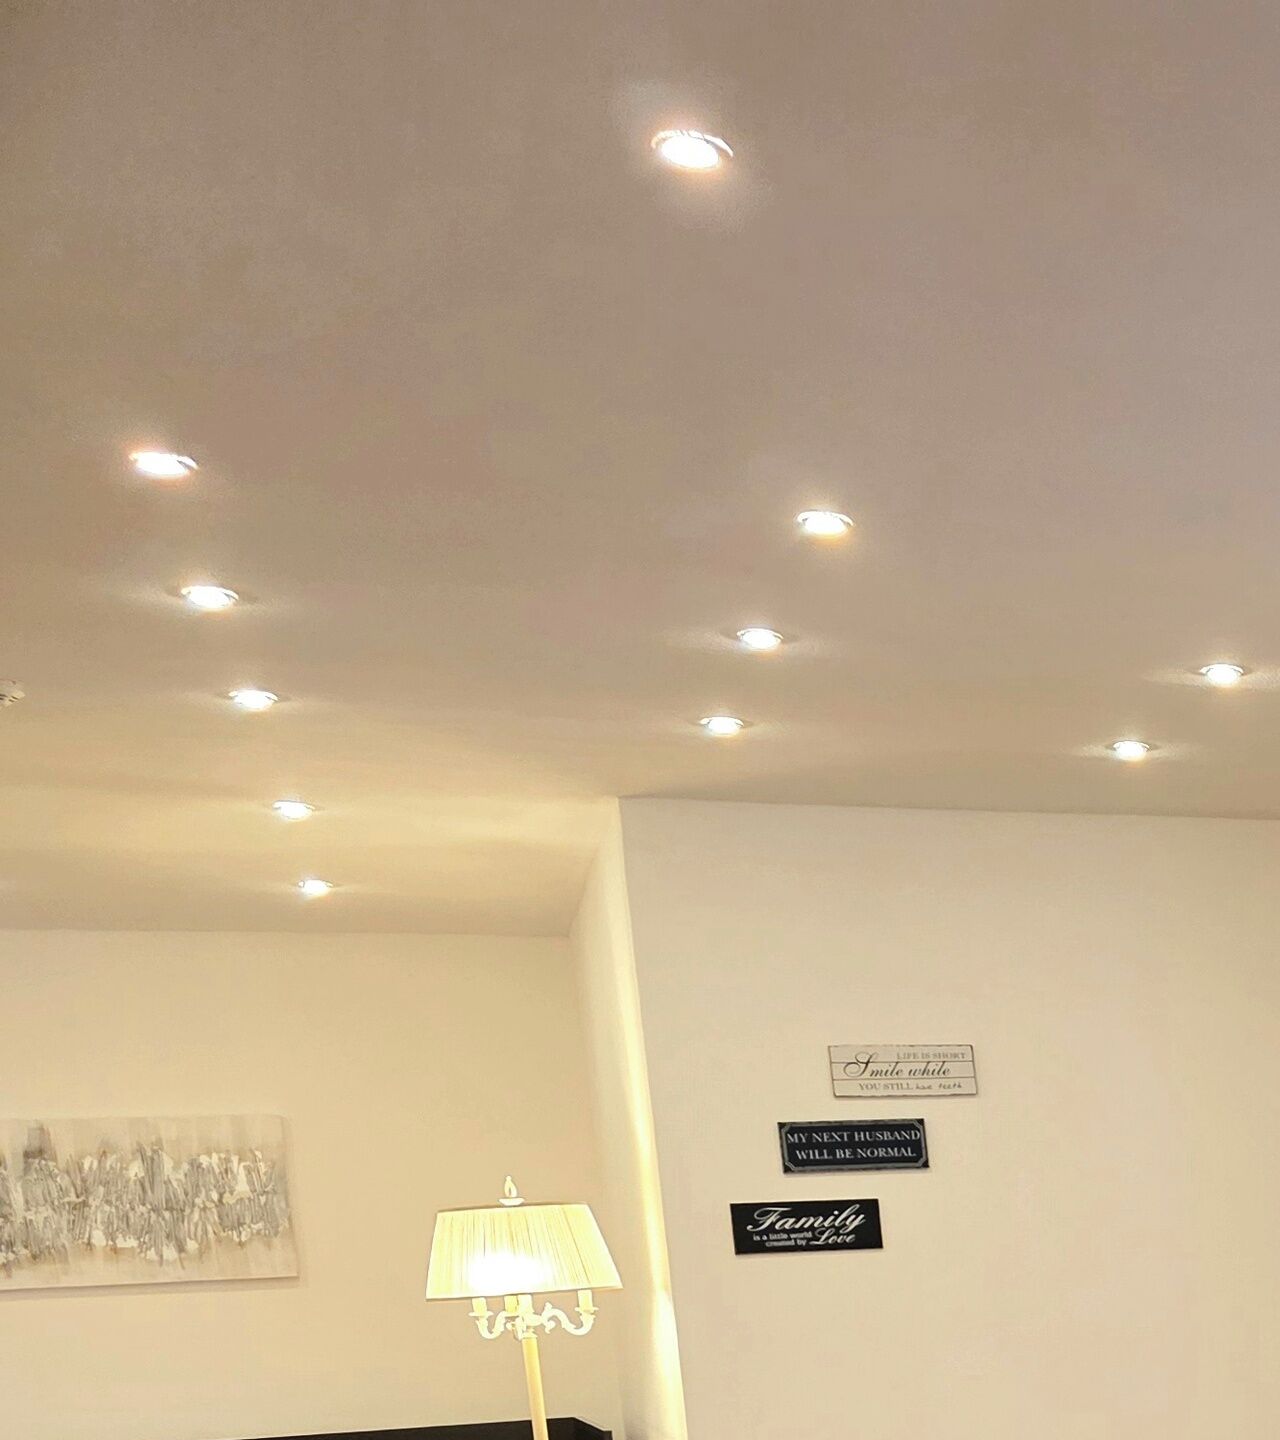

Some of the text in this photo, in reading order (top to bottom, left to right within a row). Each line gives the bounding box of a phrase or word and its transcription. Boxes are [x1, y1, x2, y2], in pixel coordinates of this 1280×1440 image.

[896, 1051, 966, 1060] LIFE IS SHORT
[843, 1051, 951, 1077] Smile while
[858, 1083, 881, 1091] YOU
[883, 1082, 913, 1090] STILL
[787, 1130, 921, 1143] MY NEXT HUSBAND
[795, 1146, 917, 1160] WILL BE NORMAL
[746, 1203, 866, 1234] Family
[753, 1233, 761, 1241] is
[796, 1238, 807, 1247] by
[809, 1227, 856, 1245] Love
